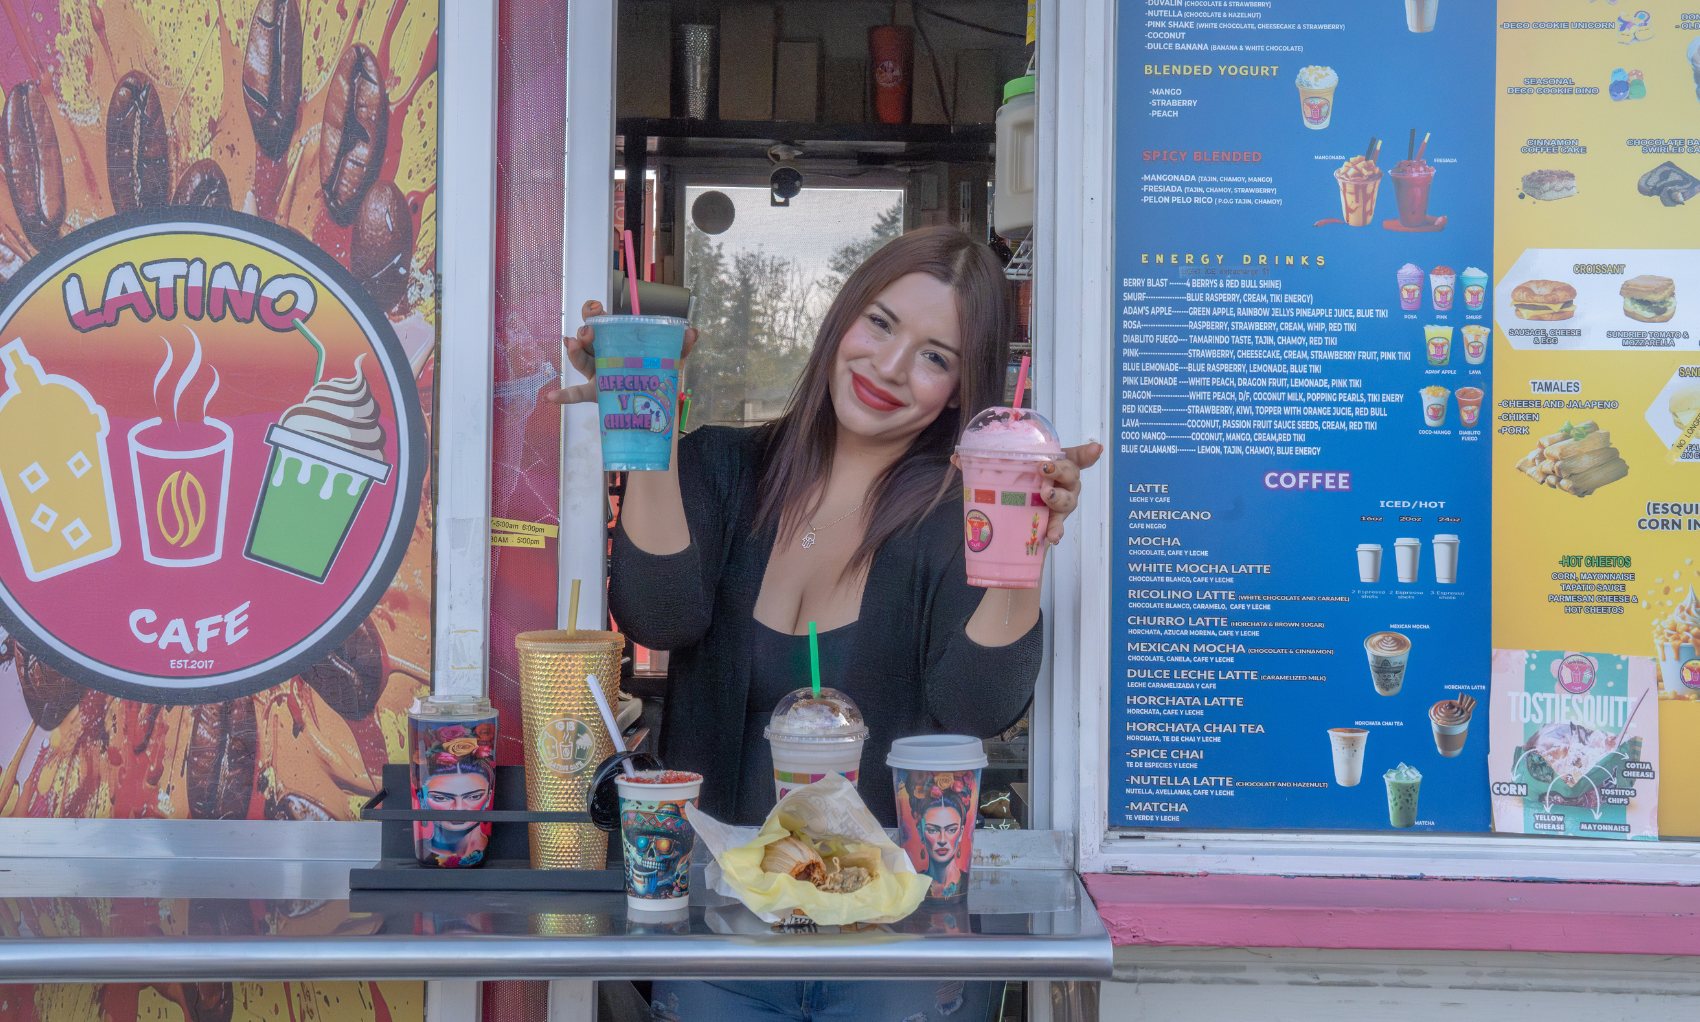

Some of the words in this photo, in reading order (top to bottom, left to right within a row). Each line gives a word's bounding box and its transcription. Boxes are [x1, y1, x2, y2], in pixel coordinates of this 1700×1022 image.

[1145, 9, 1183, 17] -NUTELLA
[1184, 11, 1222, 19] (CHOCOLATE
[1145, 20, 1166, 28] -PINK
[1168, 20, 1194, 28] SHAKE
[1196, 22, 1218, 30] (WHITE
[1302, 23, 1345, 31] STRAWBERRY)
[1500, 21, 1531, 29] -DECO
[1531, 21, 1569, 29] COOKIE
[1570, 21, 1615, 30] UNICORN
[1145, 31, 1186, 39] -COCONUT
[1144, 42, 1173, 50] -DULCE
[1210, 44, 1238, 52] (BANANA
[1144, 64, 1212, 76] BLENDED
[1218, 65, 1279, 76] YOGURT
[1523, 77, 1575, 86] SEASONAL
[1149, 88, 1182, 96] -MANGO
[1507, 86, 1535, 95] DECO
[1535, 86, 1574, 95] COOKIE
[1574, 86, 1600, 95] DINO
[1149, 99, 1198, 107] -STRABERRY
[1527, 139, 1579, 147] CINNAMON
[1521, 146, 1558, 154] COFFEE
[1560, 146, 1587, 154] CAKE
[1142, 151, 1188, 162] SPICY
[1193, 151, 1262, 162] BLENDED
[1141, 174, 1196, 182] -MANGONADA
[1141, 185, 1183, 193] -FRESIADA
[1141, 254, 1224, 265] ENERGY
[1243, 254, 1325, 266] DRINKS
[1572, 263, 1626, 275] CROISSANT
[1123, 278, 1146, 287] BERRY
[1147, 278, 1168, 287] BLAST
[62, 258, 317, 332] LATINO
[1508, 328, 1549, 338] SAUSAGE,
[1548, 328, 1582, 338] CHEESE
[1189, 335, 1230, 344] TAMARINDO
[1231, 335, 1253, 345] TASTE,
[1254, 335, 1276, 346] TAJIN,
[1277, 336, 1308, 347] CHAMOY,
[1309, 336, 1323, 345] RED
[1324, 336, 1337, 345] TIKI
[1540, 336, 1558, 345] EGG
[1622, 339, 1675, 347] MOZZARELLA
[598, 375, 660, 393] CAFECITO
[1122, 377, 1139, 385] PINK
[1140, 377, 1177, 386] LEMONADE
[1530, 381, 1581, 393] TAMALES
[617, 394, 630, 412] Y
[1498, 399, 1542, 409] -CHEESE
[1542, 399, 1565, 409] AND
[1566, 399, 1619, 409] JALAPENO
[1498, 412, 1540, 422] -CHIKEN
[604, 414, 652, 431] CHISME
[1497, 426, 1530, 435] -PORK
[1265, 472, 1349, 489] COFFEE
[1129, 483, 1168, 494] LATTE
[1380, 500, 1446, 509] ICED/HOT
[1128, 509, 1211, 520] AMERICANO
[1638, 518, 1682, 530] CORN
[517, 537, 540, 545] 5:00pm
[1129, 536, 1181, 546] MOCHA
[1558, 555, 1584, 567] -HOT
[1584, 555, 1632, 568] CHEETOS
[1128, 562, 1173, 573] WHITE
[1176, 563, 1228, 574] MOCHA
[1231, 563, 1271, 575] LATTE
[1551, 572, 1579, 582] CORN,
[1579, 572, 1635, 581] MAYONNAISE
[1560, 584, 1595, 592] TAPATIO
[1597, 584, 1626, 592] SAUCE
[1128, 589, 1192, 599] RICOLINO
[1196, 590, 1235, 600] LATTE
[1548, 594, 1595, 603] PARMESAN
[1595, 594, 1630, 603] CHEESE
[1564, 606, 1583, 614] HOT
[1584, 606, 1624, 614] CHEETOS
[1127, 615, 1185, 626] CHURRO
[1188, 616, 1228, 627] LATTE
[128, 601, 251, 654] CAFE
[1128, 642, 1189, 653] MEXICAN
[1193, 643, 1246, 654] MOCHA
[170, 659, 214, 670] EST.2017
[1127, 669, 1170, 679] DULCE
[1174, 669, 1215, 680] LECHE
[1218, 670, 1258, 680] LATTE
[1127, 695, 1201, 706] HORCHATA
[1204, 696, 1243, 706] LATTE
[1126, 722, 1201, 733] HORCHATA
[1203, 723, 1236, 733] CHAI
[1239, 724, 1265, 733] TEA
[1126, 748, 1167, 759] -SPICE
[1170, 750, 1203, 759] CHAI
[1626, 762, 1651, 770] COTIJA
[1125, 774, 1191, 786] -NUTELLA
[1194, 776, 1233, 786] LATTE
[1493, 783, 1527, 796] CORN
[1601, 789, 1636, 797] TOSTITOS
[1125, 802, 1188, 812] -MATCHA
[1534, 823, 1565, 831] CHEEASE
[1580, 824, 1630, 832] MAYONNAISE
